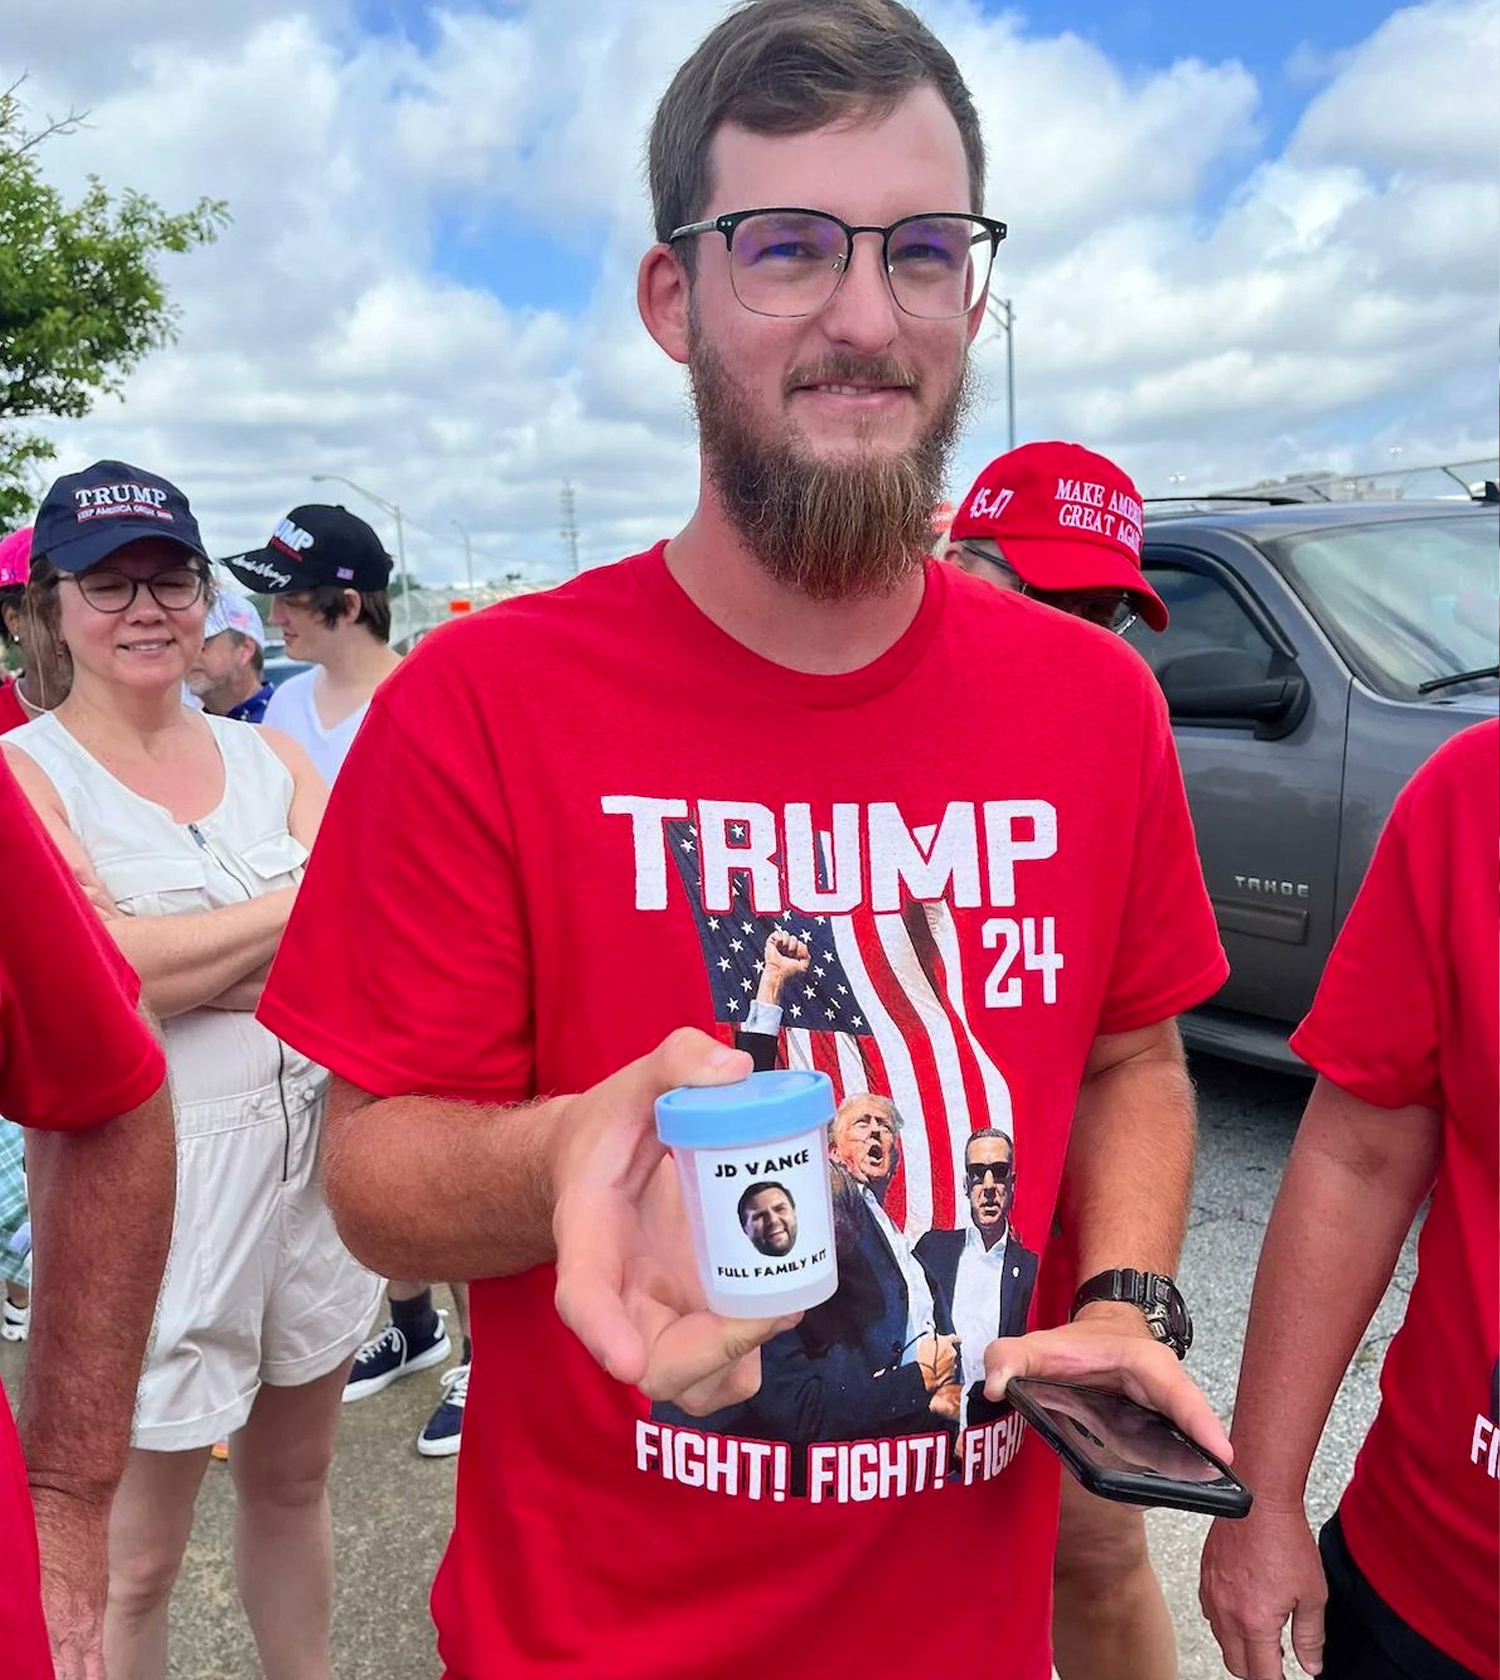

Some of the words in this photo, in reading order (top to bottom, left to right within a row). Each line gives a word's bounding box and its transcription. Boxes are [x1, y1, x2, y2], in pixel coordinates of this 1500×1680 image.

[75, 484, 167, 508] TRUMP
[1054, 478, 1105, 507] MAKE
[1059, 503, 1116, 537] GREAT
[601, 795, 1058, 914] TRUMP
[1234, 875, 1309, 898] TAHOE
[981, 916, 1064, 1009] 24
[714, 1164, 738, 1178] JD
[745, 1149, 810, 1176] VANCE
[717, 1266, 749, 1278] FULL
[754, 1257, 807, 1278] FAMILY
[811, 1248, 827, 1265] KIT
[636, 1418, 789, 1502] FIGHT!
[811, 1434, 948, 1504] FIGHT!
